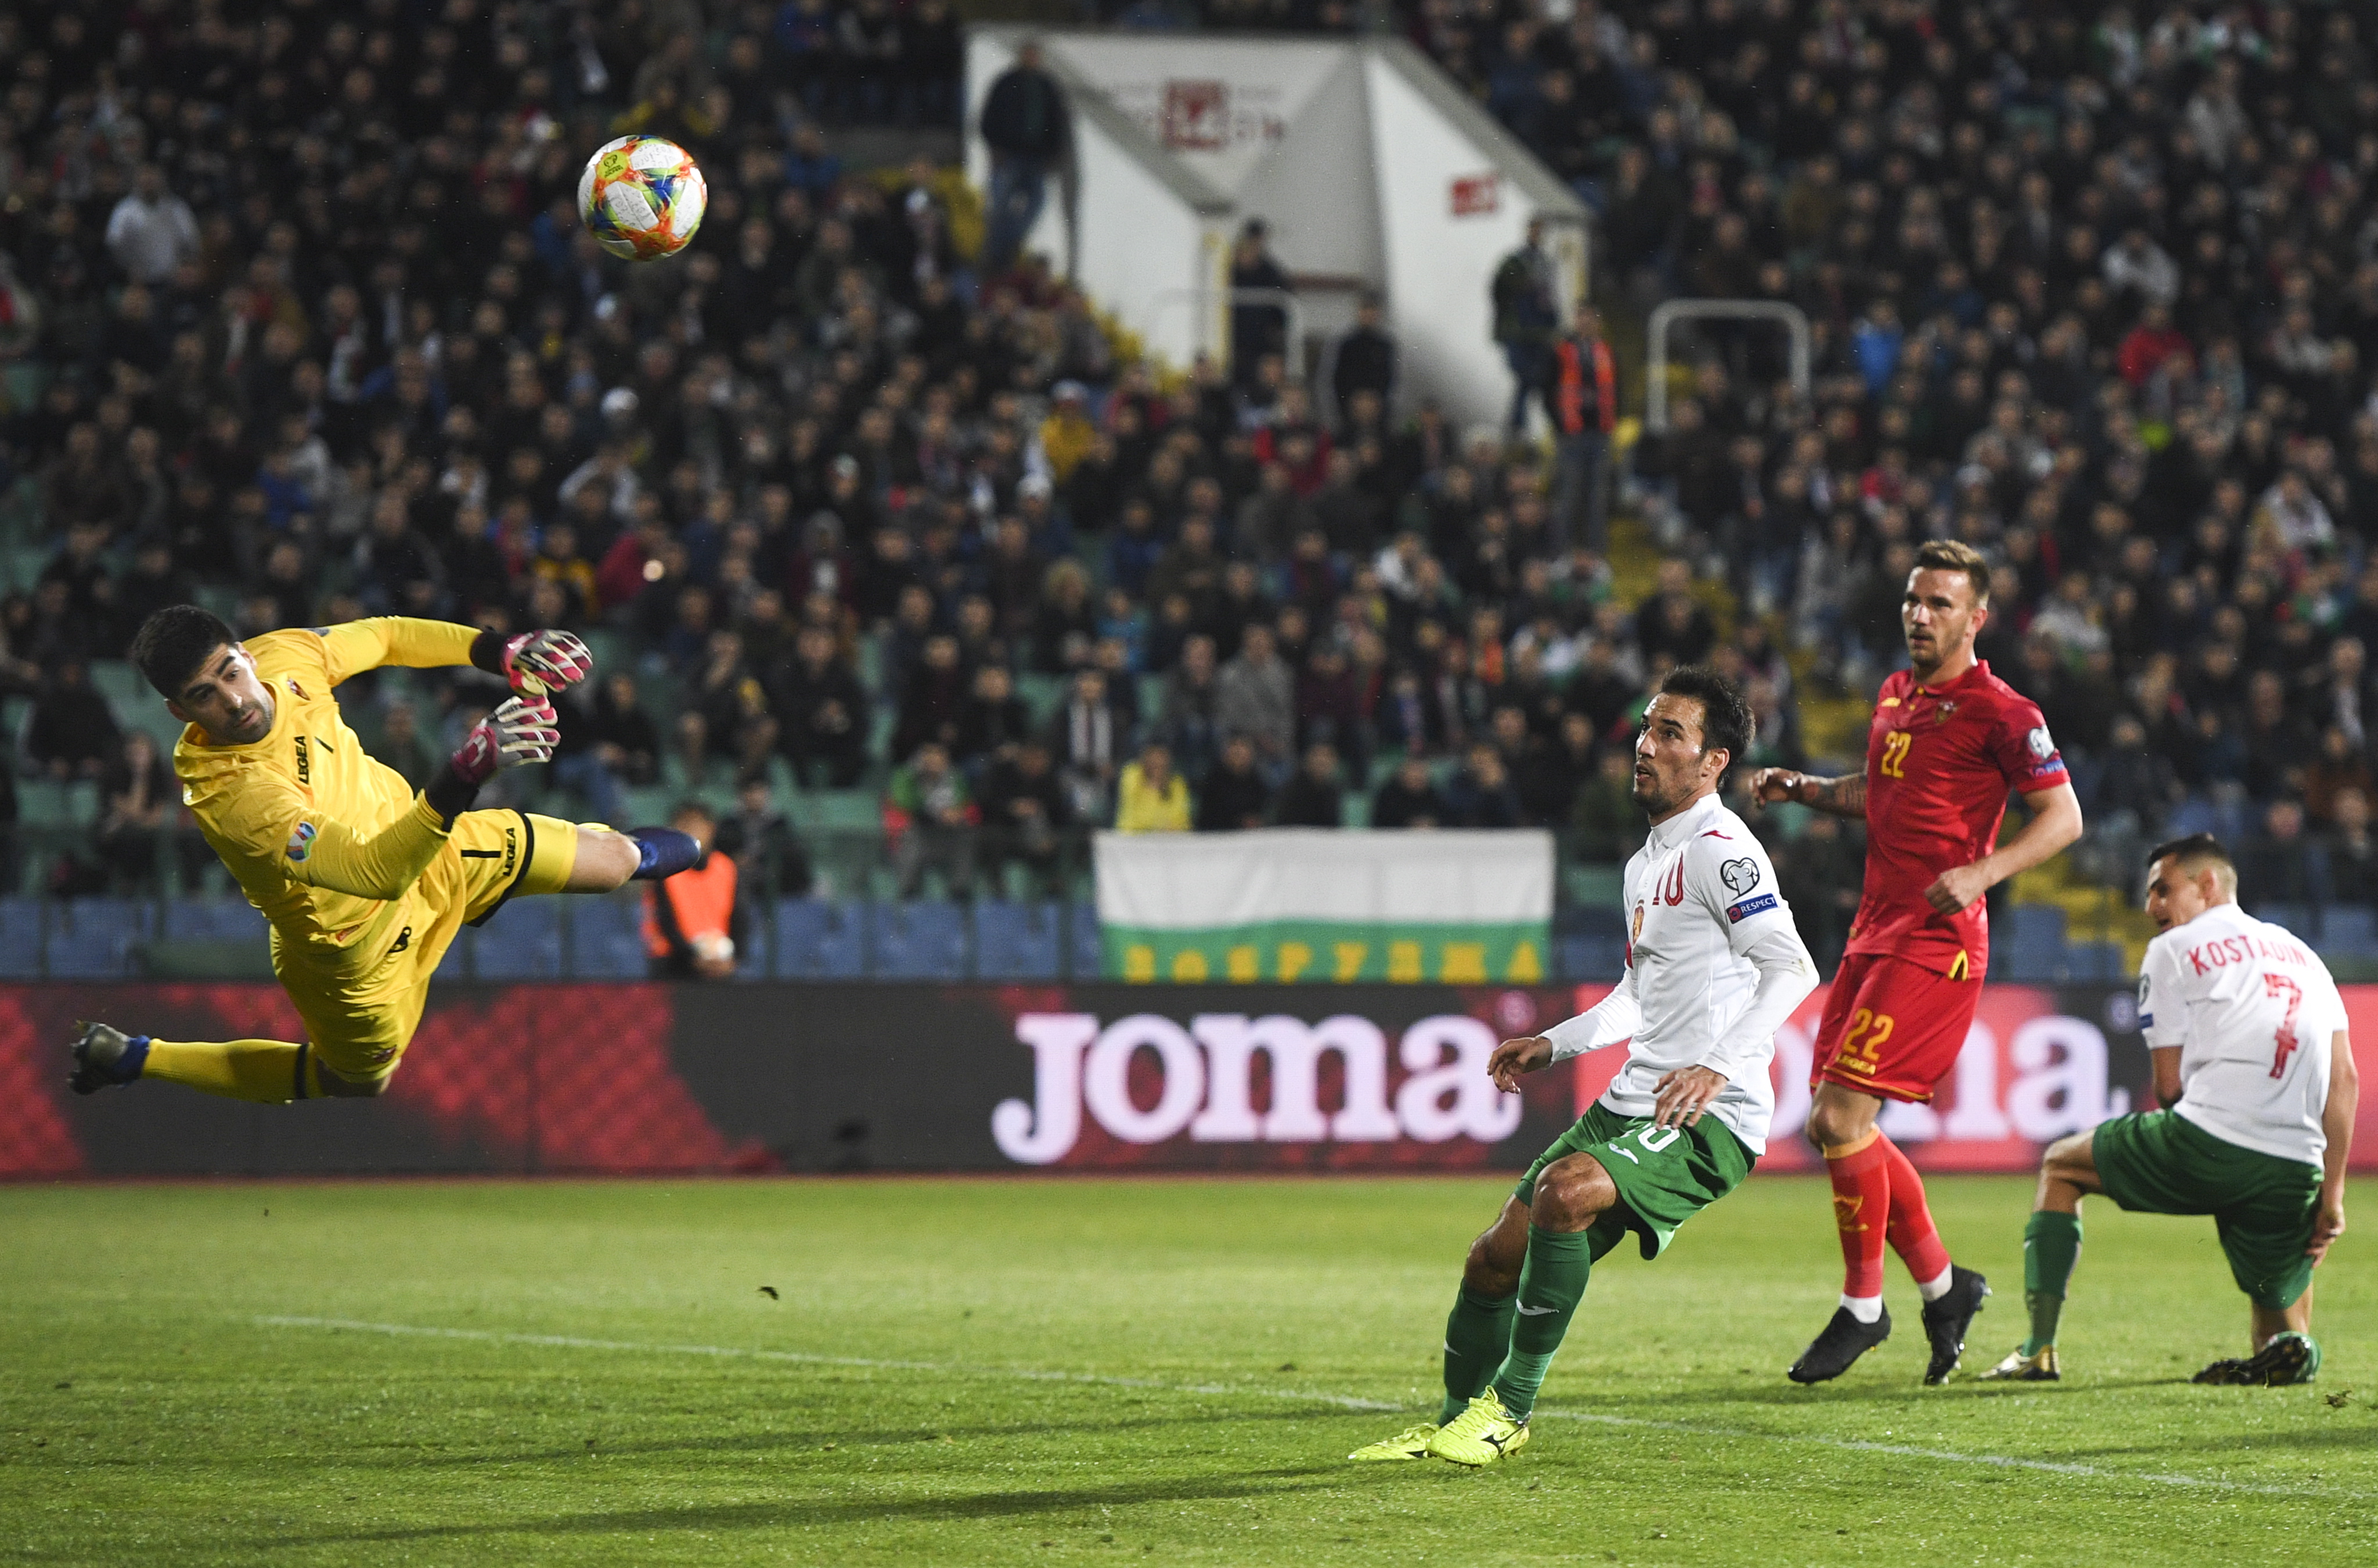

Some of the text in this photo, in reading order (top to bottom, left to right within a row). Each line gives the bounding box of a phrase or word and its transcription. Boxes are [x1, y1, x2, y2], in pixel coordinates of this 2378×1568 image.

[294, 736, 309, 785] LEGEA
[1880, 730, 1912, 778] 22
[461, 849, 502, 858] 1
[503, 827, 516, 877] LEGEA
[1652, 850, 1684, 907] 10
[1741, 897, 1774, 914] RESPECT
[2188, 935, 2323, 978] KOSTADIN
[1842, 1007, 1895, 1063] 22
[2262, 973, 2303, 1080] 7
